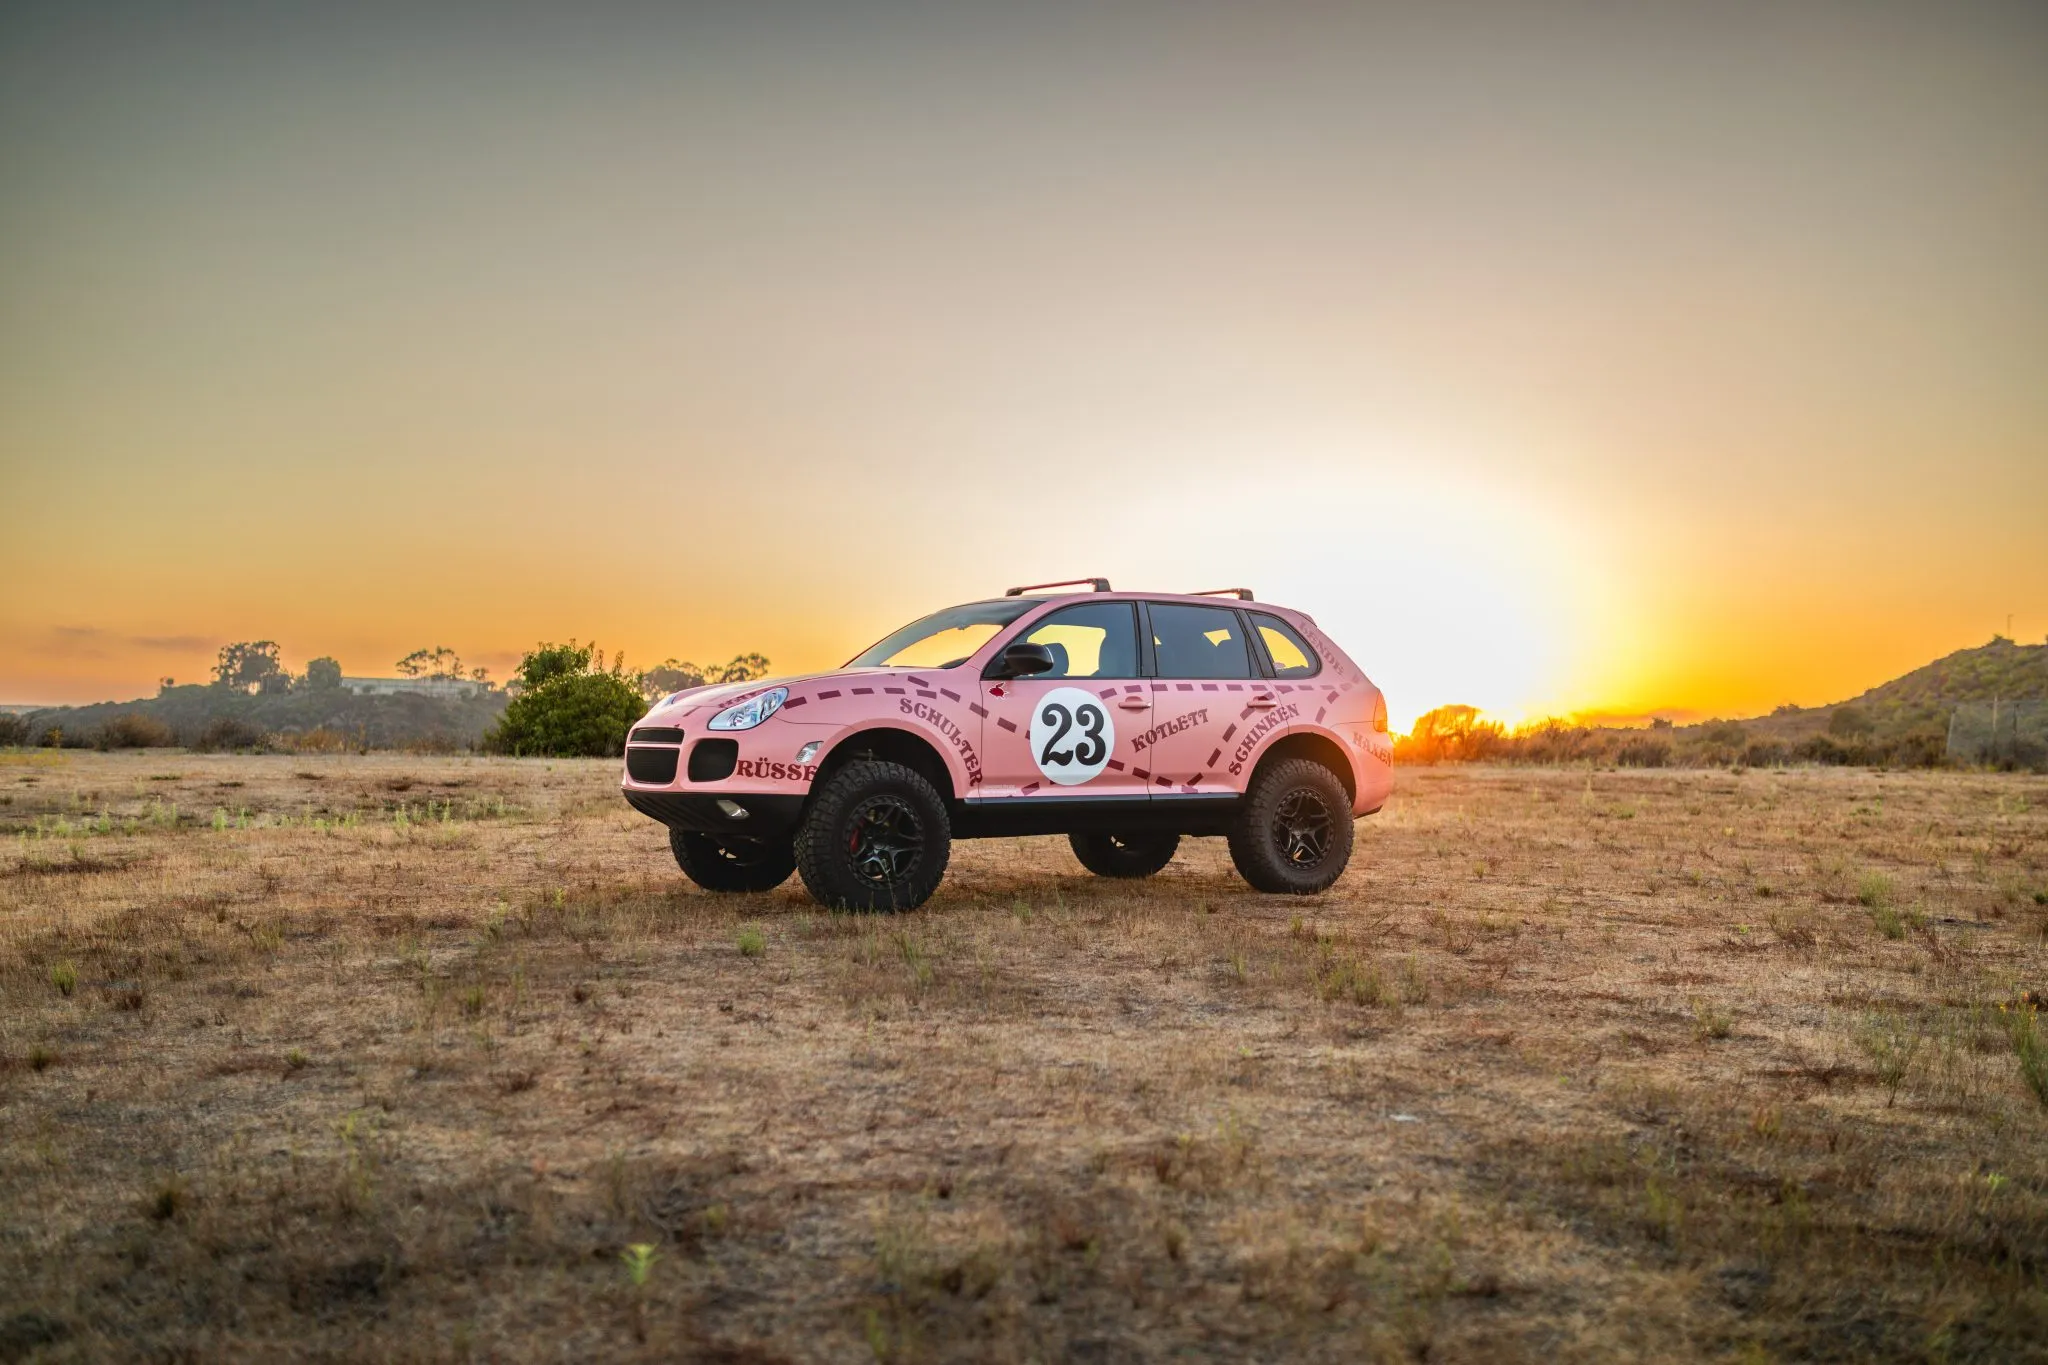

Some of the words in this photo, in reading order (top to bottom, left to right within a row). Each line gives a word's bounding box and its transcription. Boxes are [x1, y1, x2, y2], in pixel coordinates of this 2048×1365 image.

[900, 698, 983, 787] SCHULTER
[1041, 703, 1106, 766] 23
[1131, 708, 1209, 753] KOTLETT
[1228, 703, 1300, 776] SCHINKEN
